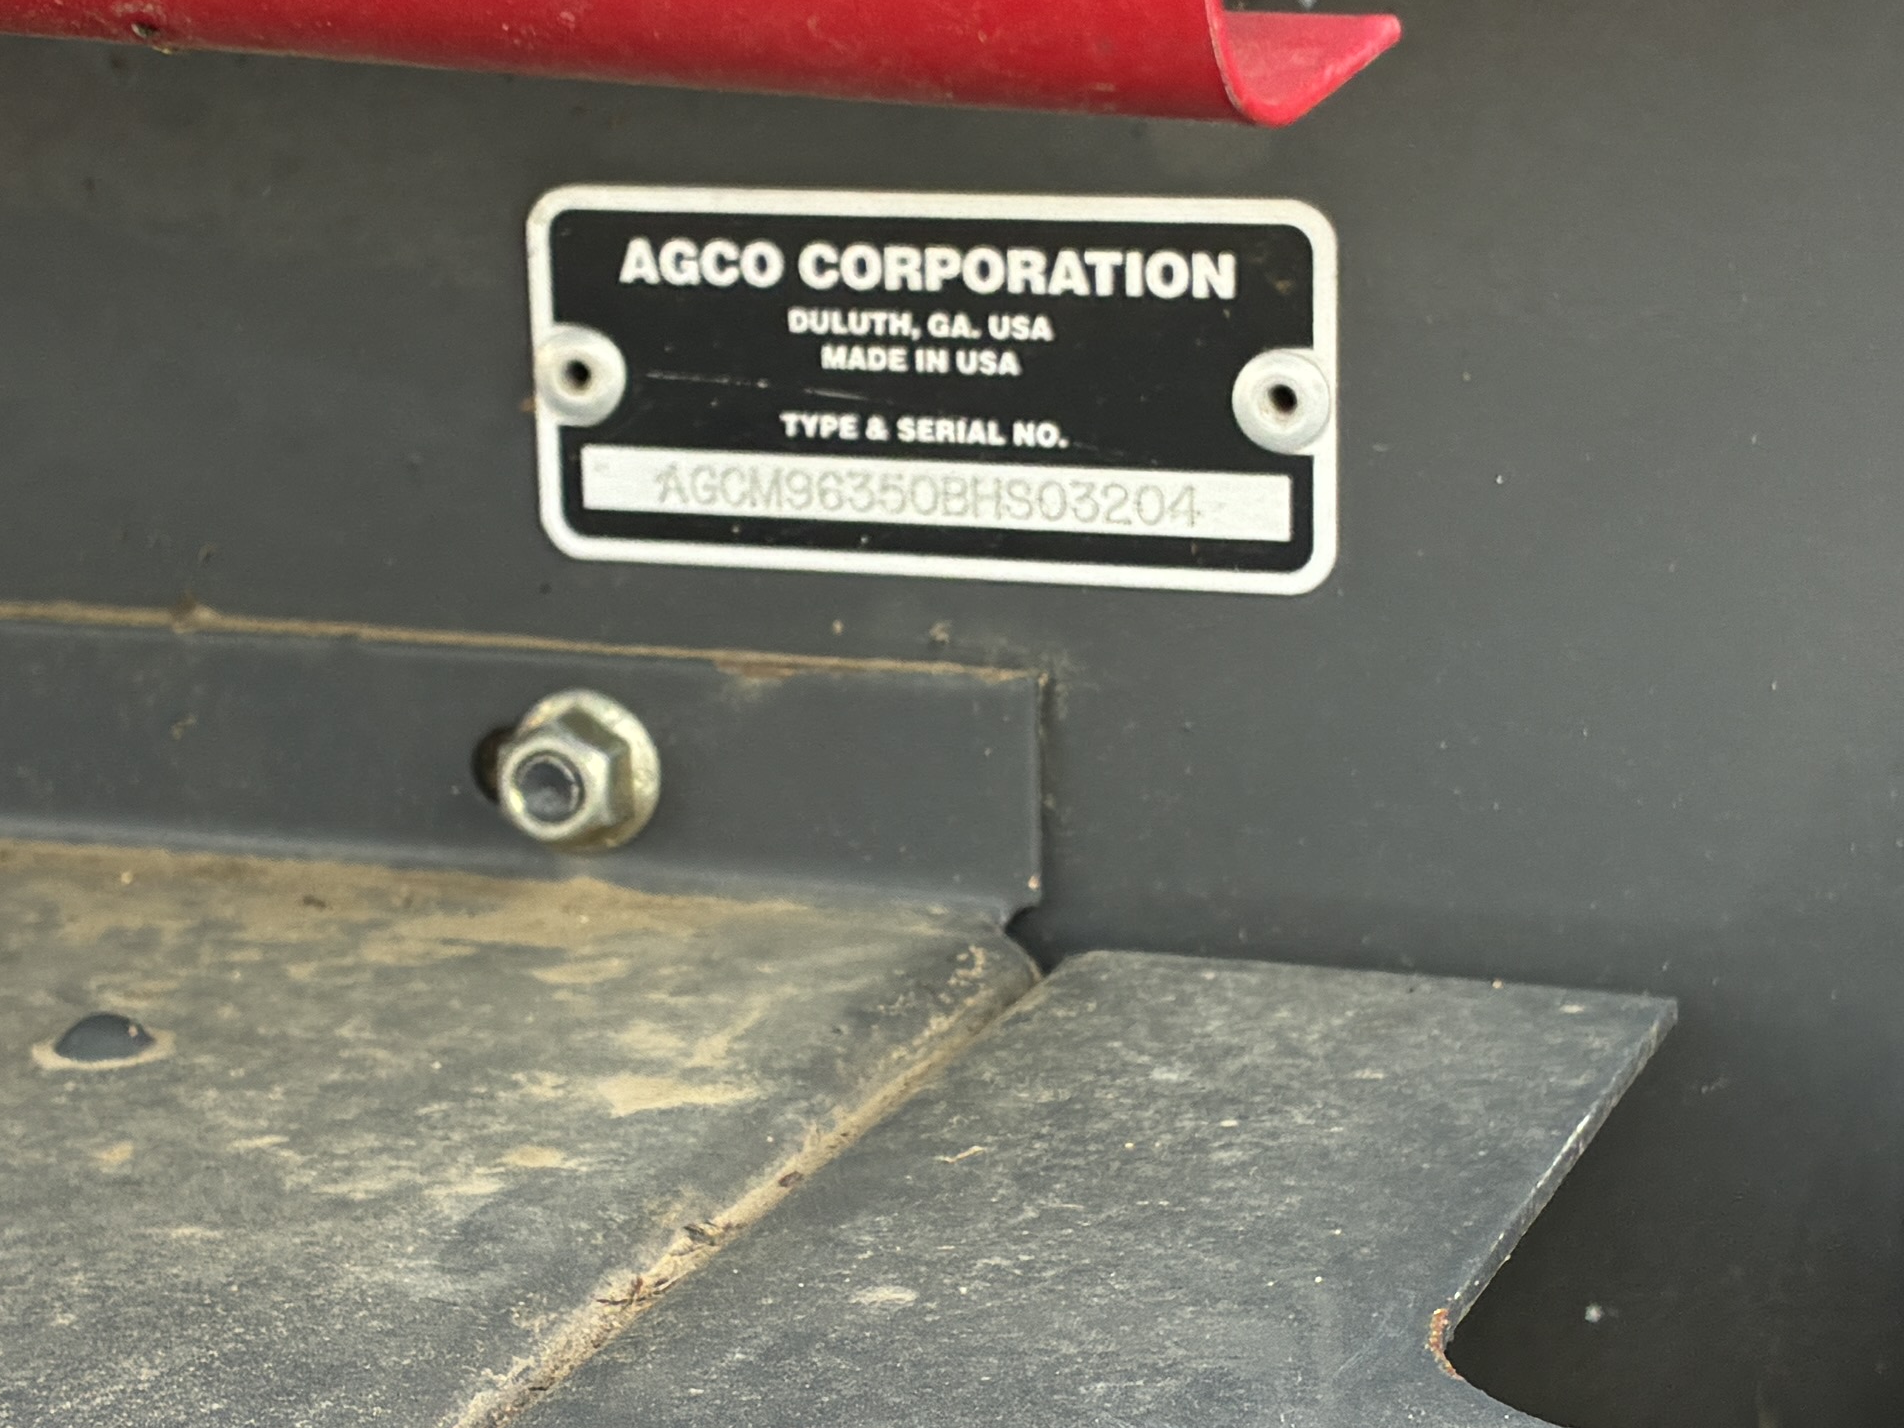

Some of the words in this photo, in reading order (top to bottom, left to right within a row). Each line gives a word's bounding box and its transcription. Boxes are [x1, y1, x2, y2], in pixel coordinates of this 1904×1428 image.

[620, 238, 784, 288] AGCO
[798, 240, 1236, 299] CORPORATION
[788, 307, 921, 339] DULUTH,
[926, 313, 981, 339] GA.
[987, 315, 1054, 341] USA
[821, 345, 908, 373] MADE
[914, 348, 947, 373] IN
[955, 348, 1021, 377] USA
[779, 413, 860, 439] TYPE
[865, 416, 887, 441] &
[895, 417, 1006, 446] SERIAL
[1013, 422, 1068, 448] NO.
